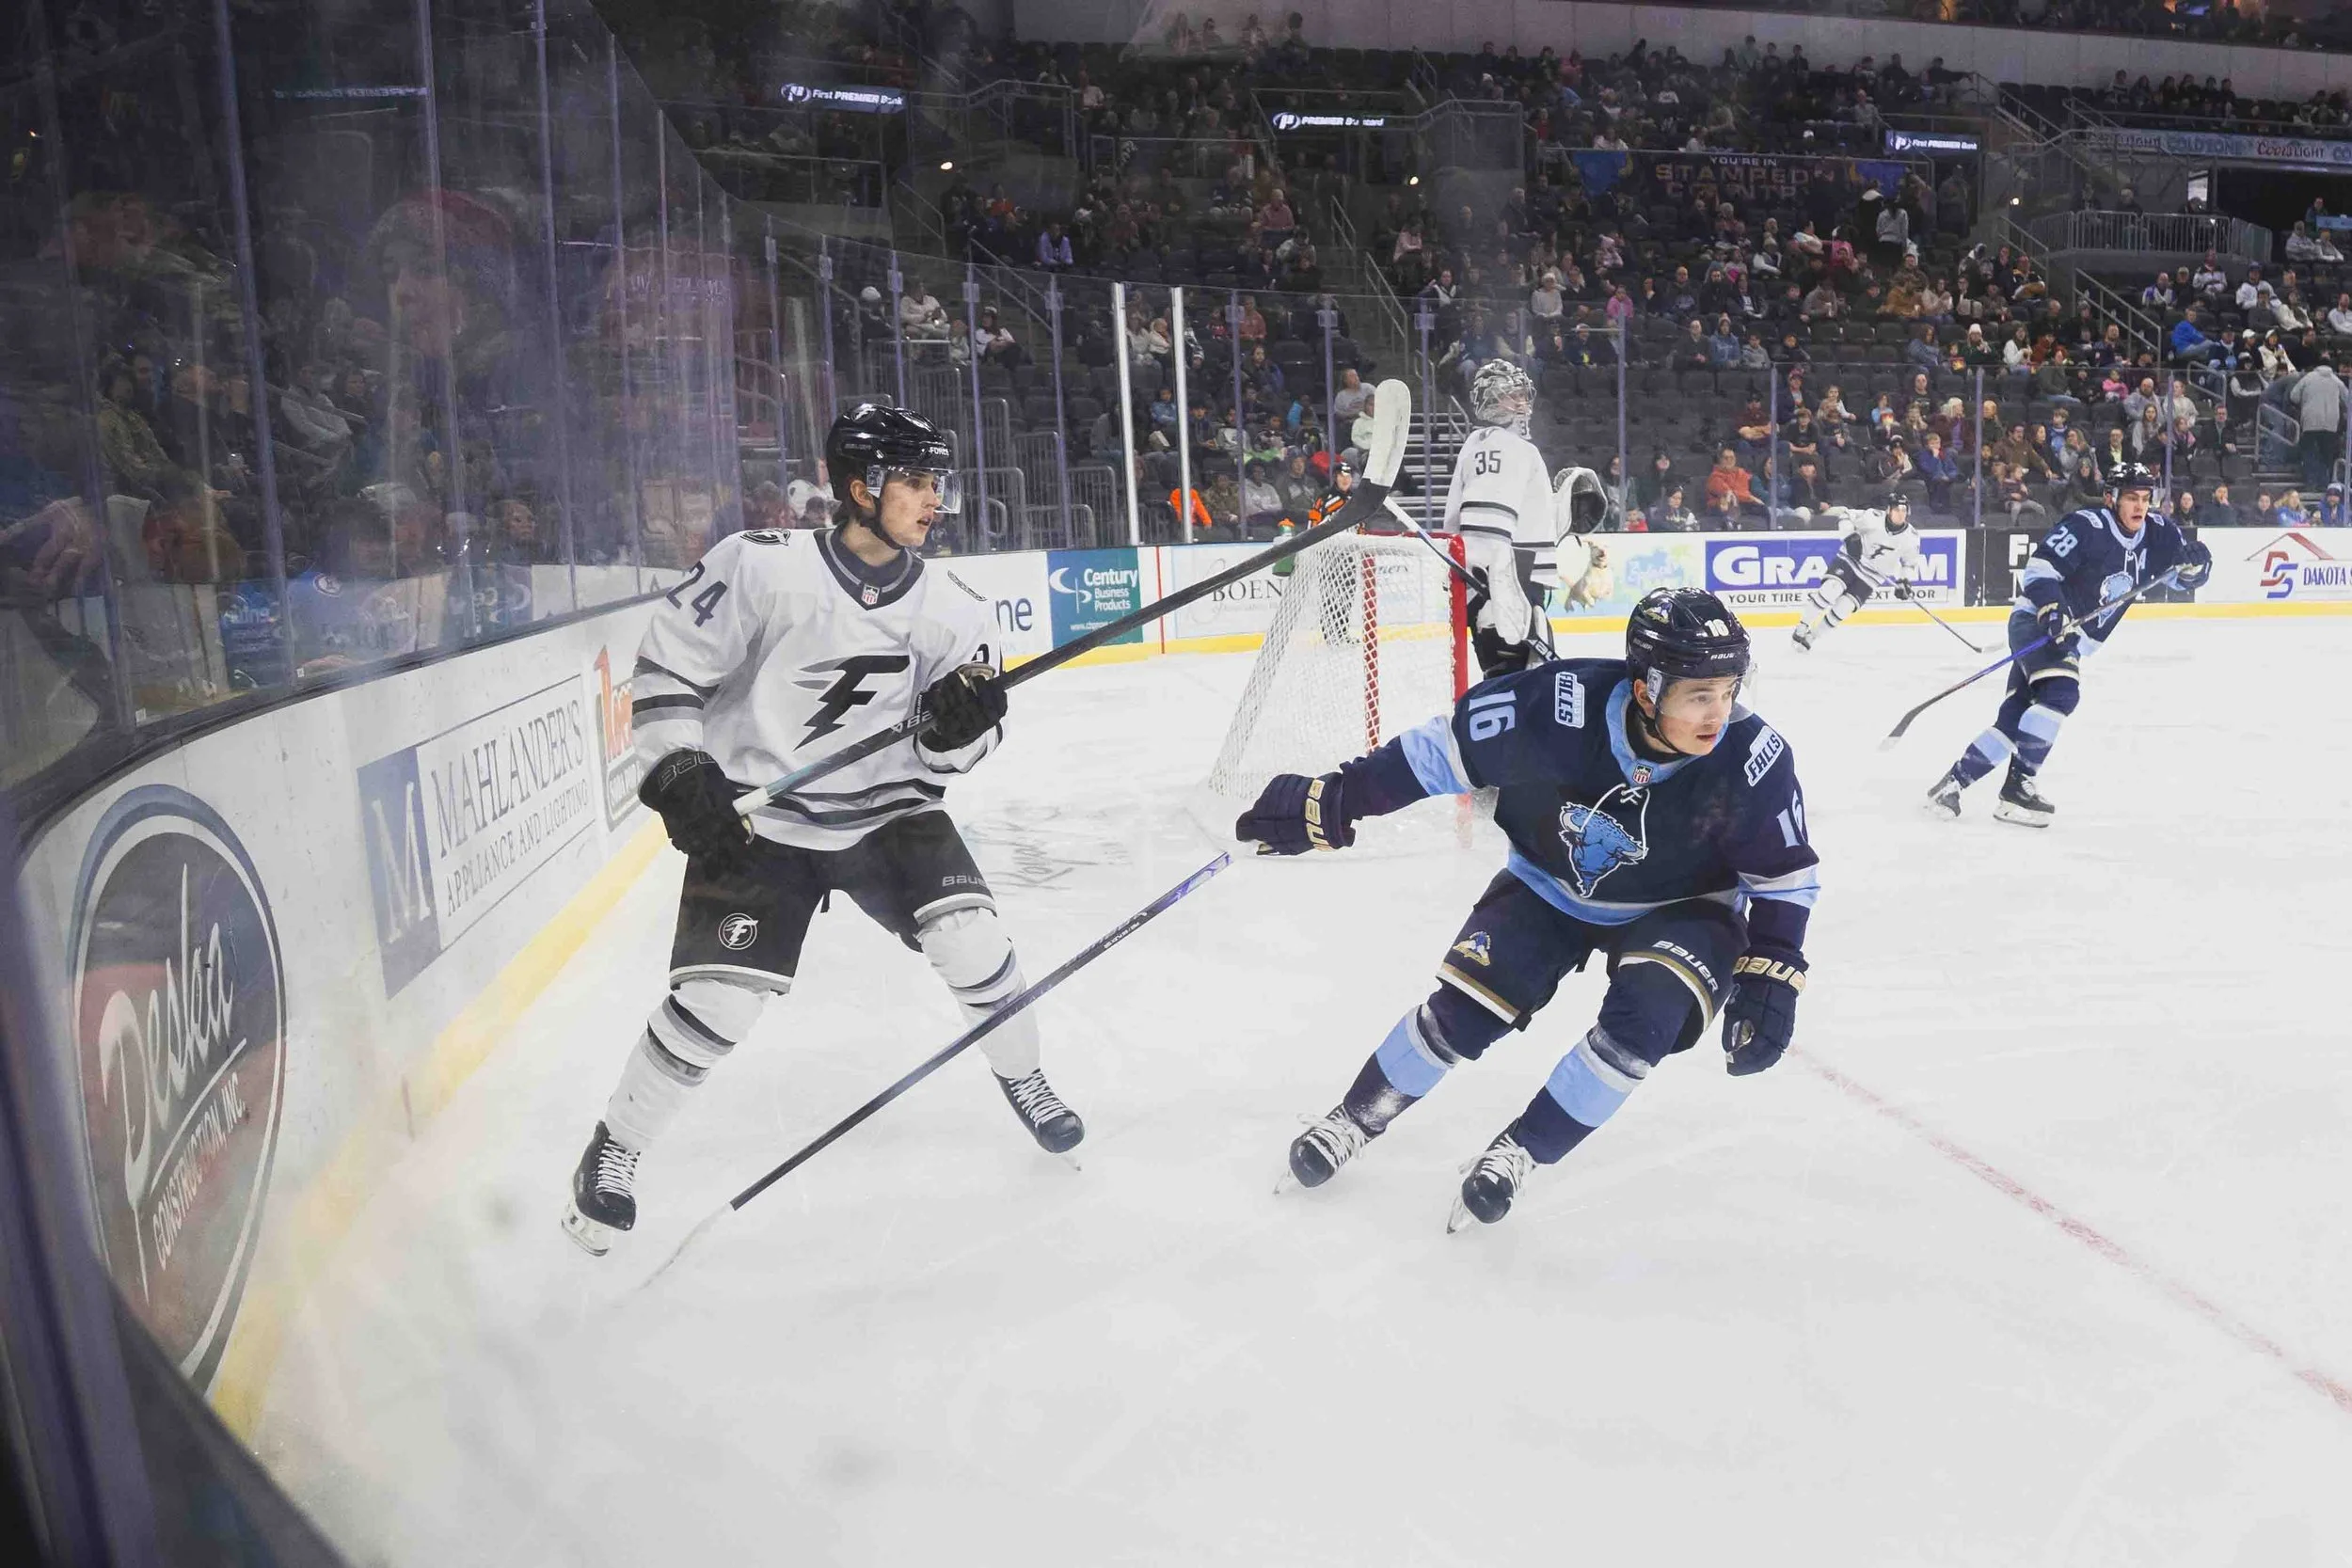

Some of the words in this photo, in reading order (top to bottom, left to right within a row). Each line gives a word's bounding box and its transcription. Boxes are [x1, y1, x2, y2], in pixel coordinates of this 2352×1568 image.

[813, 89, 833, 99] First
[834, 91, 880, 103] PREMIER
[881, 95, 902, 104] Bank
[1301, 117, 1343, 125] PREMIER
[1928, 140, 1961, 149] PREMIER
[1655, 163, 1809, 184] STAMPED
[1763, 158, 1777, 166] IN
[1475, 451, 1501, 475] 35
[2045, 526, 2078, 558] 28
[1084, 568, 1138, 588] Century
[1712, 546, 1947, 586] GRAM
[2303, 566, 2346, 586] DAKOTA
[666, 561, 728, 627] 24
[1094, 587, 1130, 598] Business
[1212, 578, 1283, 602] BOEN
[1728, 593, 1766, 604] YOUR
[1772, 592, 1803, 603] TIRE
[1094, 599, 1131, 610] Products
[1705, 619, 1729, 637] 16
[1559, 673, 1573, 723] FALLS
[1469, 689, 1517, 741] 16
[1747, 734, 1781, 782] FALLS
[432, 699, 583, 859] MAHLANDER'S
[447, 830, 516, 917] APPLIANCE
[518, 813, 542, 857] AND
[543, 778, 589, 835] LIGHTING
[1651, 940, 1720, 994] BAUER
[220, 1072, 246, 1133] INC.
